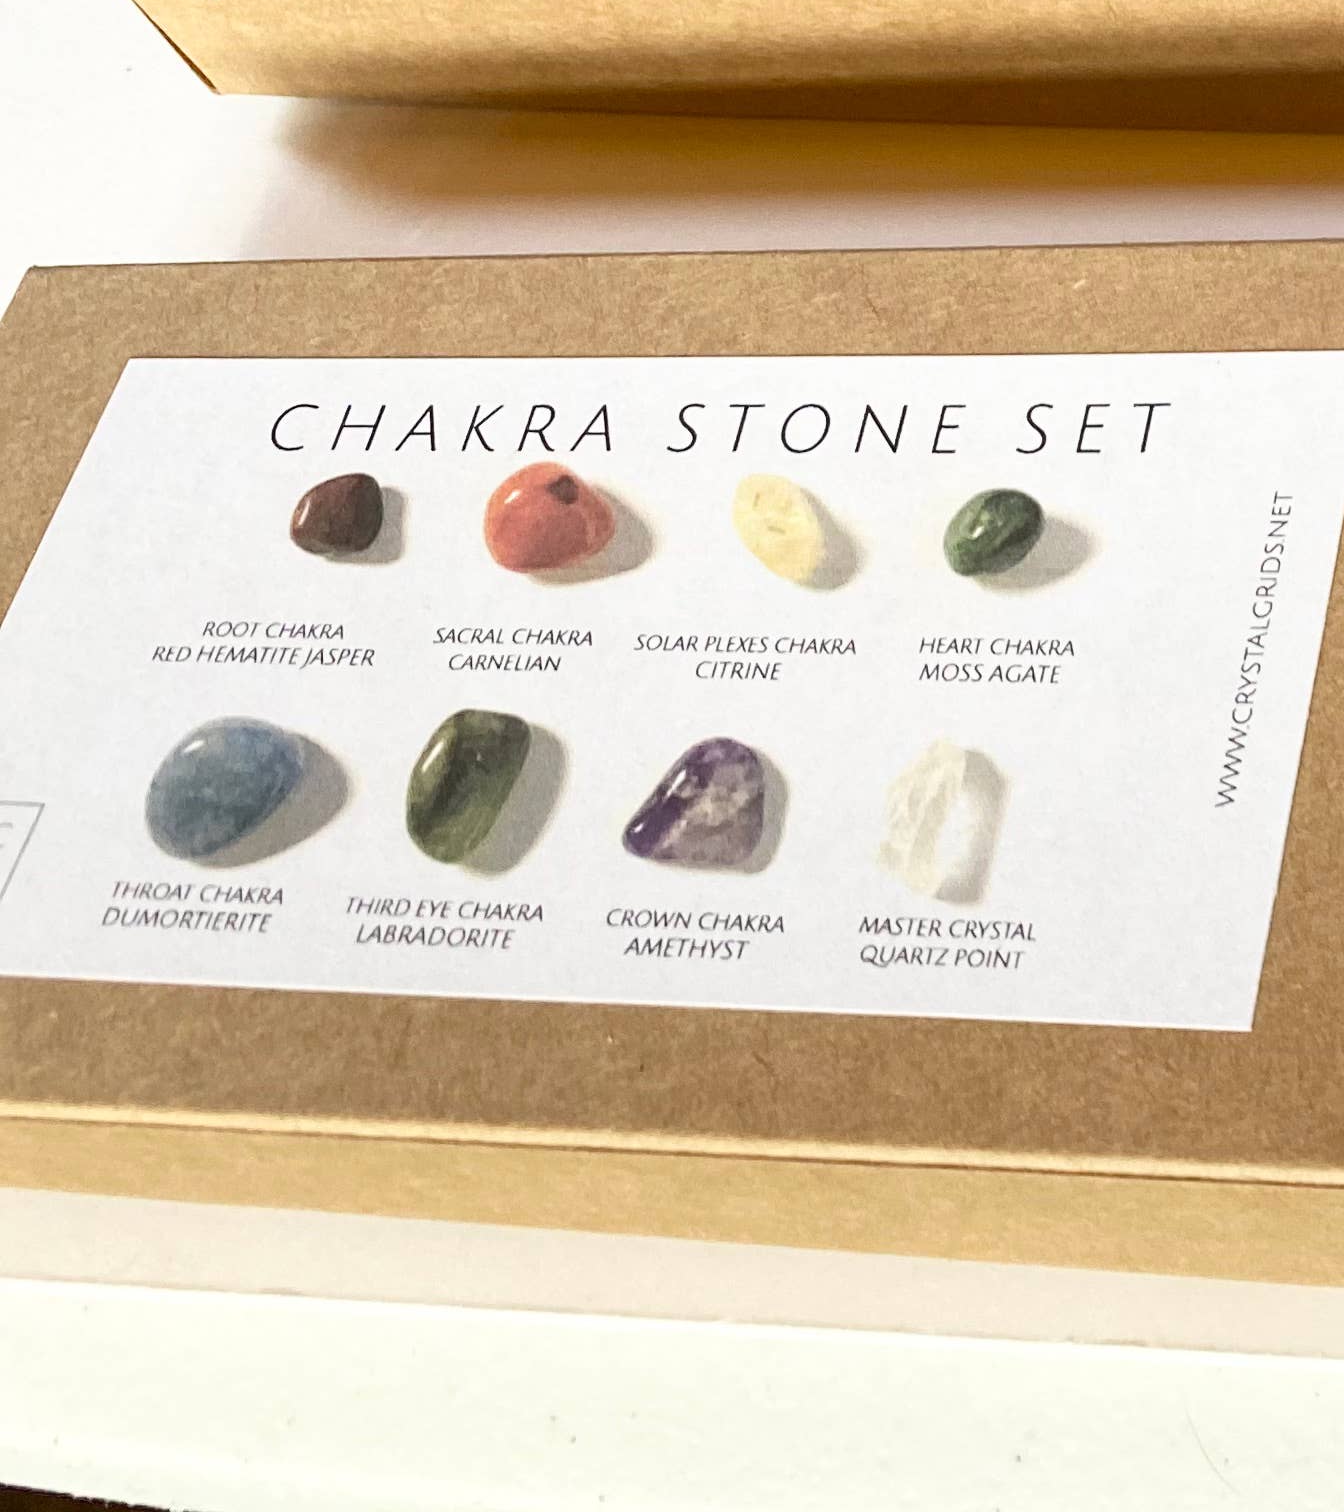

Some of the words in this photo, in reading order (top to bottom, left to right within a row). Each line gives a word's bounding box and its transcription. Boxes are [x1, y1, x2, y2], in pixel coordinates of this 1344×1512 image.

[270, 403, 613, 453] CHAKRA
[667, 403, 967, 455] STONE
[1015, 402, 1172, 455] SET
[202, 621, 260, 640] ROOT
[265, 622, 345, 640] CHAKRA
[433, 626, 505, 645] SACRAL
[511, 628, 594, 647] CHAKRA
[633, 634, 698, 654] SOLAR
[704, 636, 770, 654] PLEXES
[776, 636, 857, 656] CHAKRA
[919, 637, 984, 656] HEART
[990, 637, 1075, 657] CHAKRA
[1214, 490, 1294, 807] WWW.CRYSTALGRIDS.NET
[152, 646, 191, 664] RED
[196, 646, 302, 666] HEMATITE
[300, 647, 376, 669] JASPER
[448, 654, 560, 672] CARNELIAN
[695, 661, 782, 681] CITRINE
[919, 664, 984, 683] MOSS
[989, 664, 1061, 684] AGATE
[112, 880, 196, 903] THROAT
[200, 884, 284, 905] CHAKRA
[102, 907, 273, 934] DUMORTIERITE
[346, 896, 411, 918] THIRD
[416, 900, 454, 920] EYE
[458, 901, 544, 922] CHAKRA
[606, 907, 694, 930] CROWN
[698, 910, 786, 933] CHAKRA
[355, 923, 515, 950] LABRADORITE
[859, 916, 945, 939] MASTER
[949, 918, 1037, 942] CRYSTAL
[624, 937, 750, 960] AMETHYST
[860, 944, 949, 967] QUARTZ
[953, 946, 1025, 969] POINT
